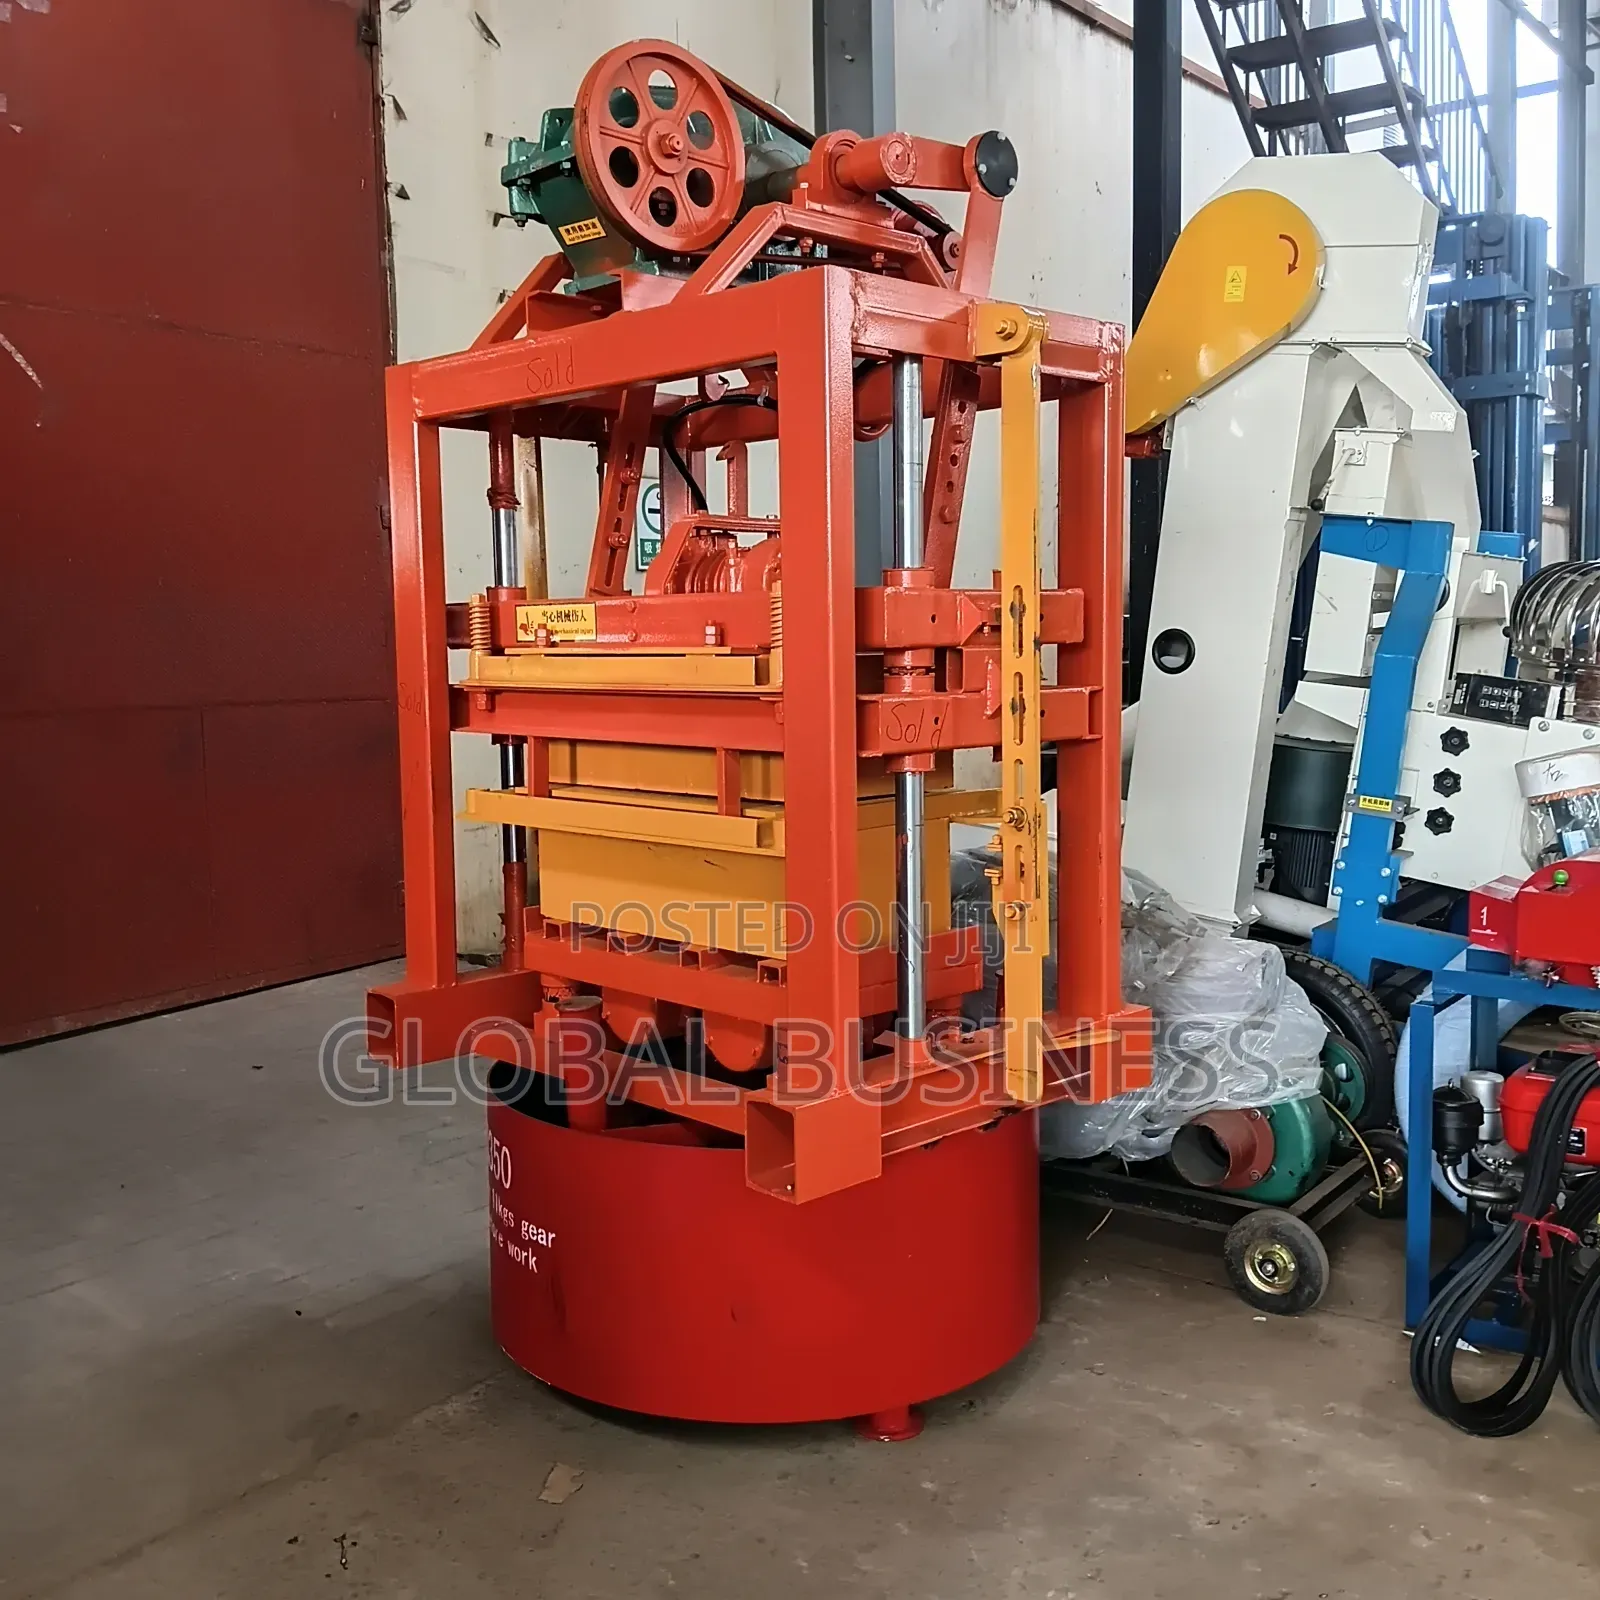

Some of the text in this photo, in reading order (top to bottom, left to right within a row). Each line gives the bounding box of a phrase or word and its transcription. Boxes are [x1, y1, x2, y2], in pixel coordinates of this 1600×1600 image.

[526, 345, 575, 394] Sold
[541, 609, 587, 623] 当心机械伤人
[886, 702, 950, 750] Sold
[521, 1219, 556, 1248] gear
[507, 1240, 538, 1273] work
